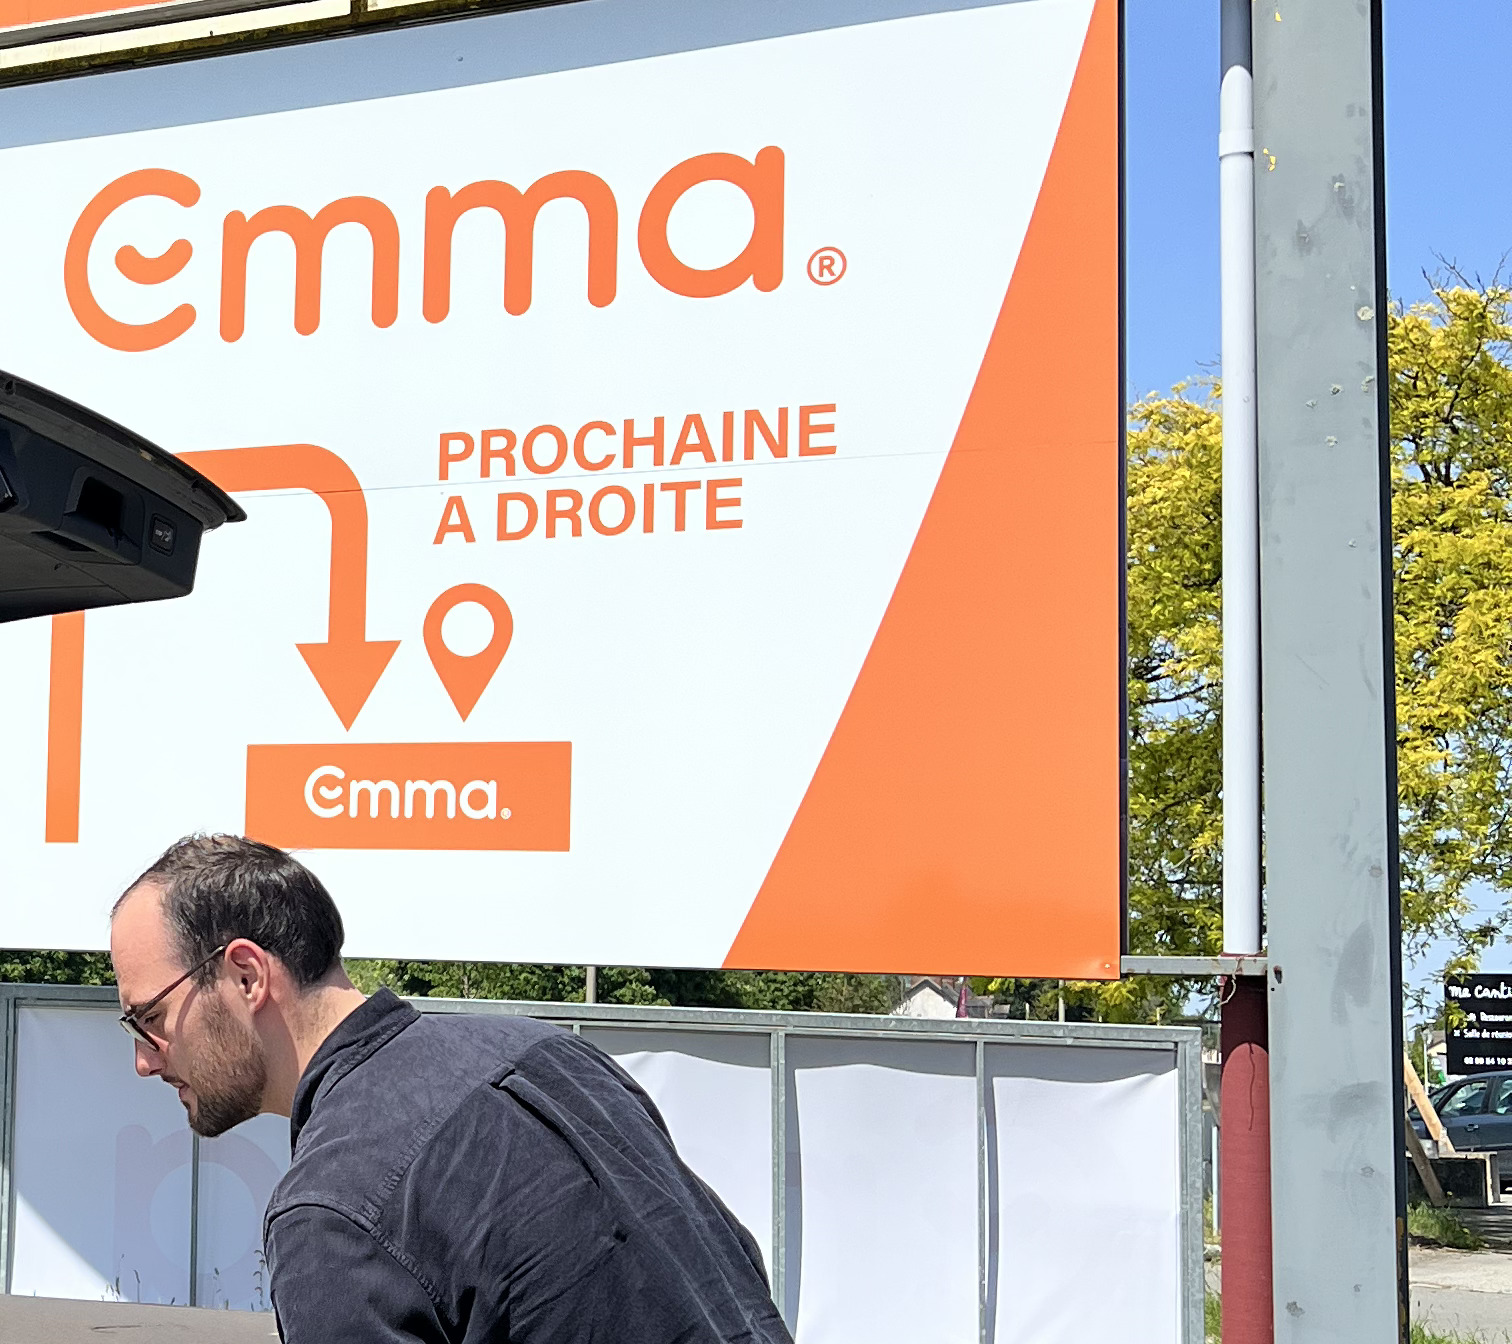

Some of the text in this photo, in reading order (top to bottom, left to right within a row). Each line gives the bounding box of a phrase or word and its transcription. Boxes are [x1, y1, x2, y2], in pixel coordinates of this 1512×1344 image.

[437, 402, 838, 482] PROCHAINE
[433, 477, 744, 546] A DROITE
